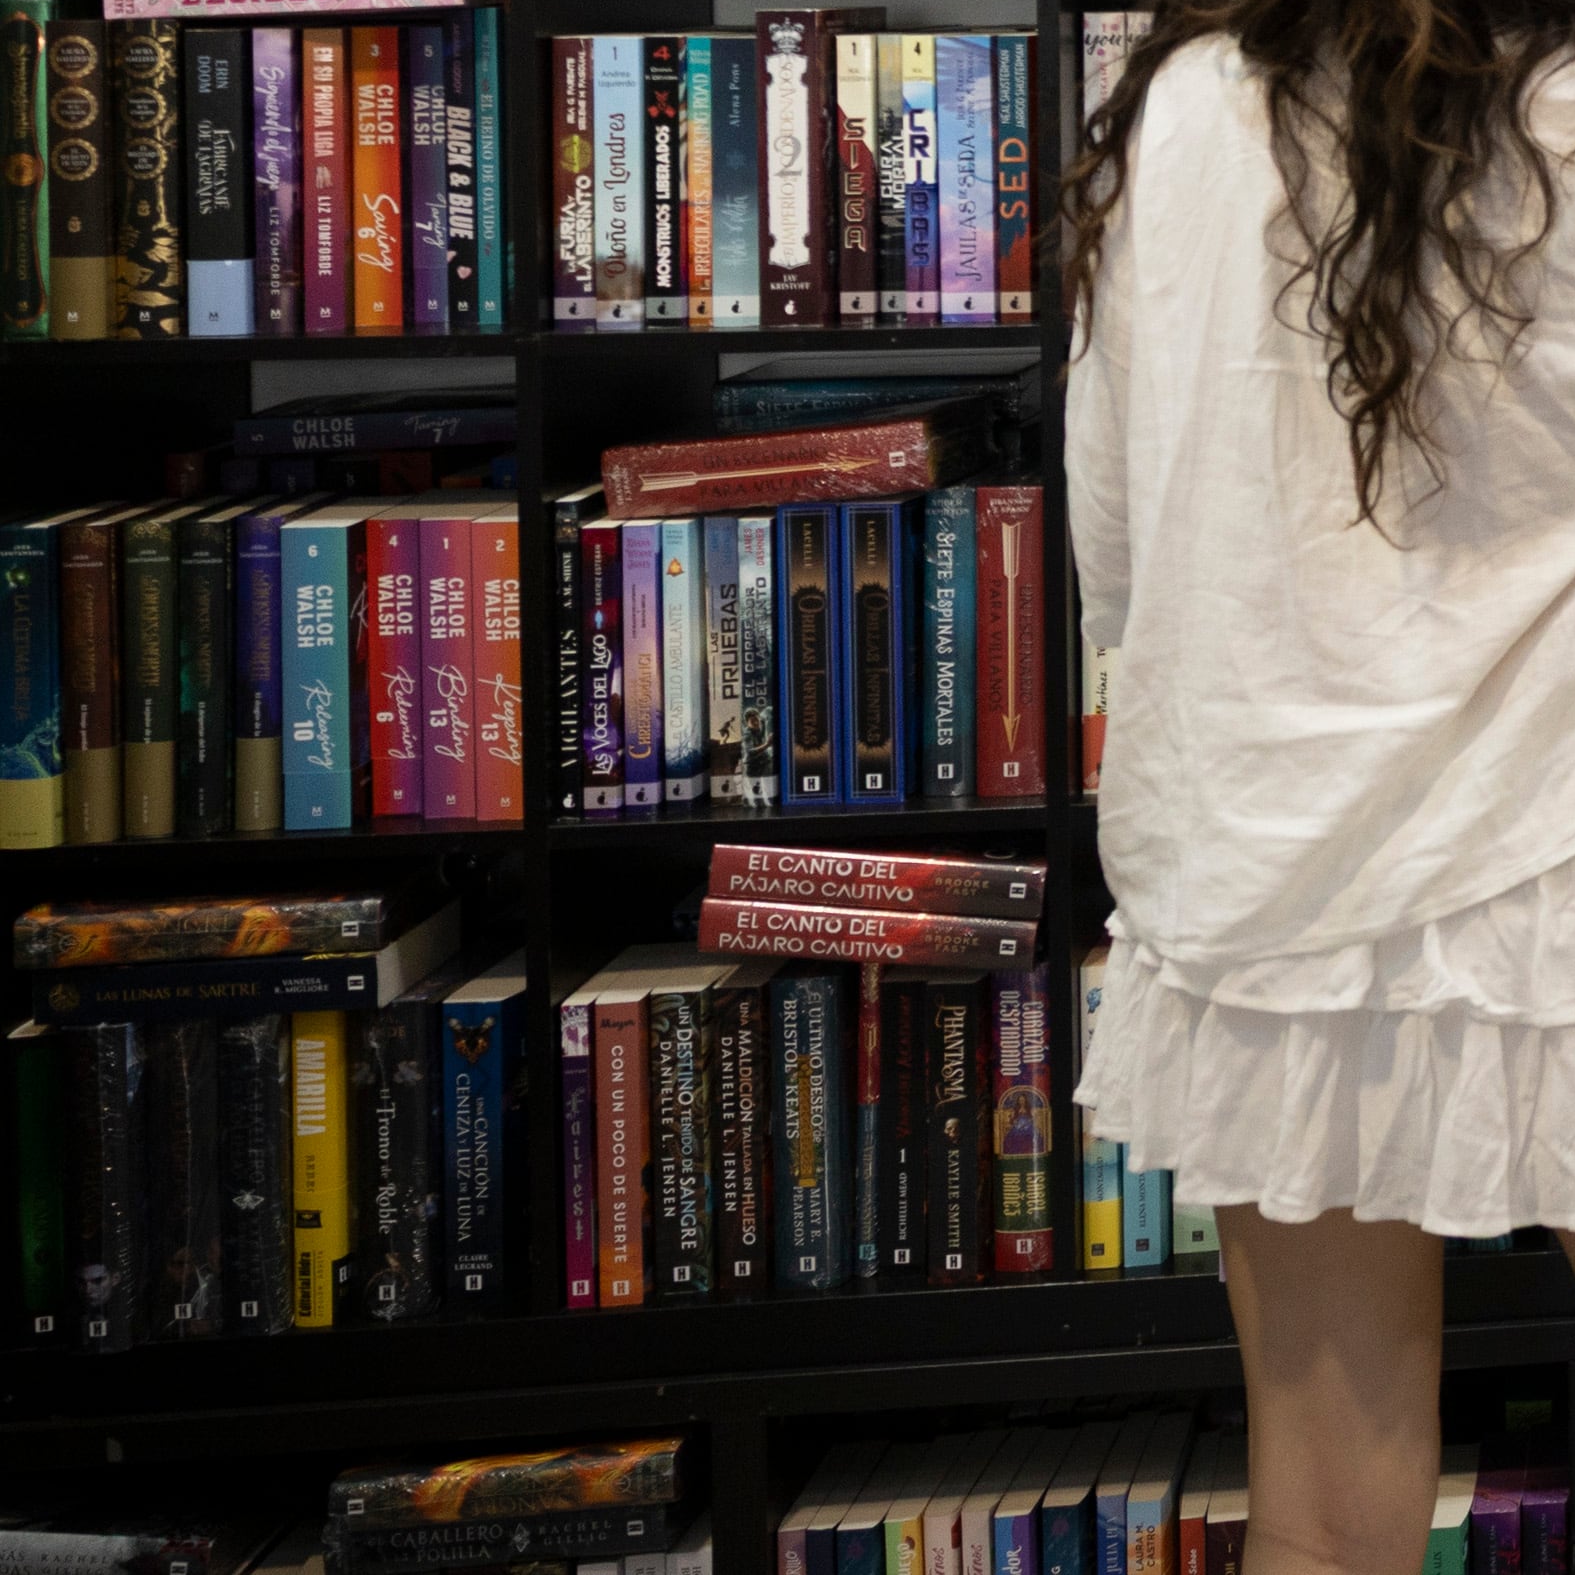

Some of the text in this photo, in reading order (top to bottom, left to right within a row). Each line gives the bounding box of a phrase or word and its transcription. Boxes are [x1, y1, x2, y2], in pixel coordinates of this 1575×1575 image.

[313, 46, 335, 156] EN SU PROPIA LIGA
[358, 84, 375, 145] WALSH
[377, 84, 394, 144] CHLOE
[728, 62, 741, 127] Alena Pons
[446, 106, 474, 240] BLACK & BLUE
[602, 112, 631, 277] Otoño en Londres
[656, 125, 671, 288] MONSTRUOS LIBERADOS
[692, 73, 711, 275] IRREGULARES NANKING ROAD
[882, 139, 894, 198] CURA
[1000, 137, 1028, 219] SED
[560, 203, 575, 260] FURIA
[576, 175, 591, 281] LABERINTO
[296, 585, 313, 648] WALSH
[315, 585, 334, 646] CHLOE
[720, 583, 739, 700] PRUEBAS
[293, 719, 314, 742] 10
[561, 629, 578, 768] VIGILANTES
[730, 872, 914, 902] PÁJARO CAUTIVO
[748, 854, 897, 879] EL CANTO DEL
[296, 1039, 326, 1136] AMARILLA
[611, 1045, 626, 1262] CON UN POCO DE SUERTE
[946, 1148, 960, 1248] KAYLIE SMITH
